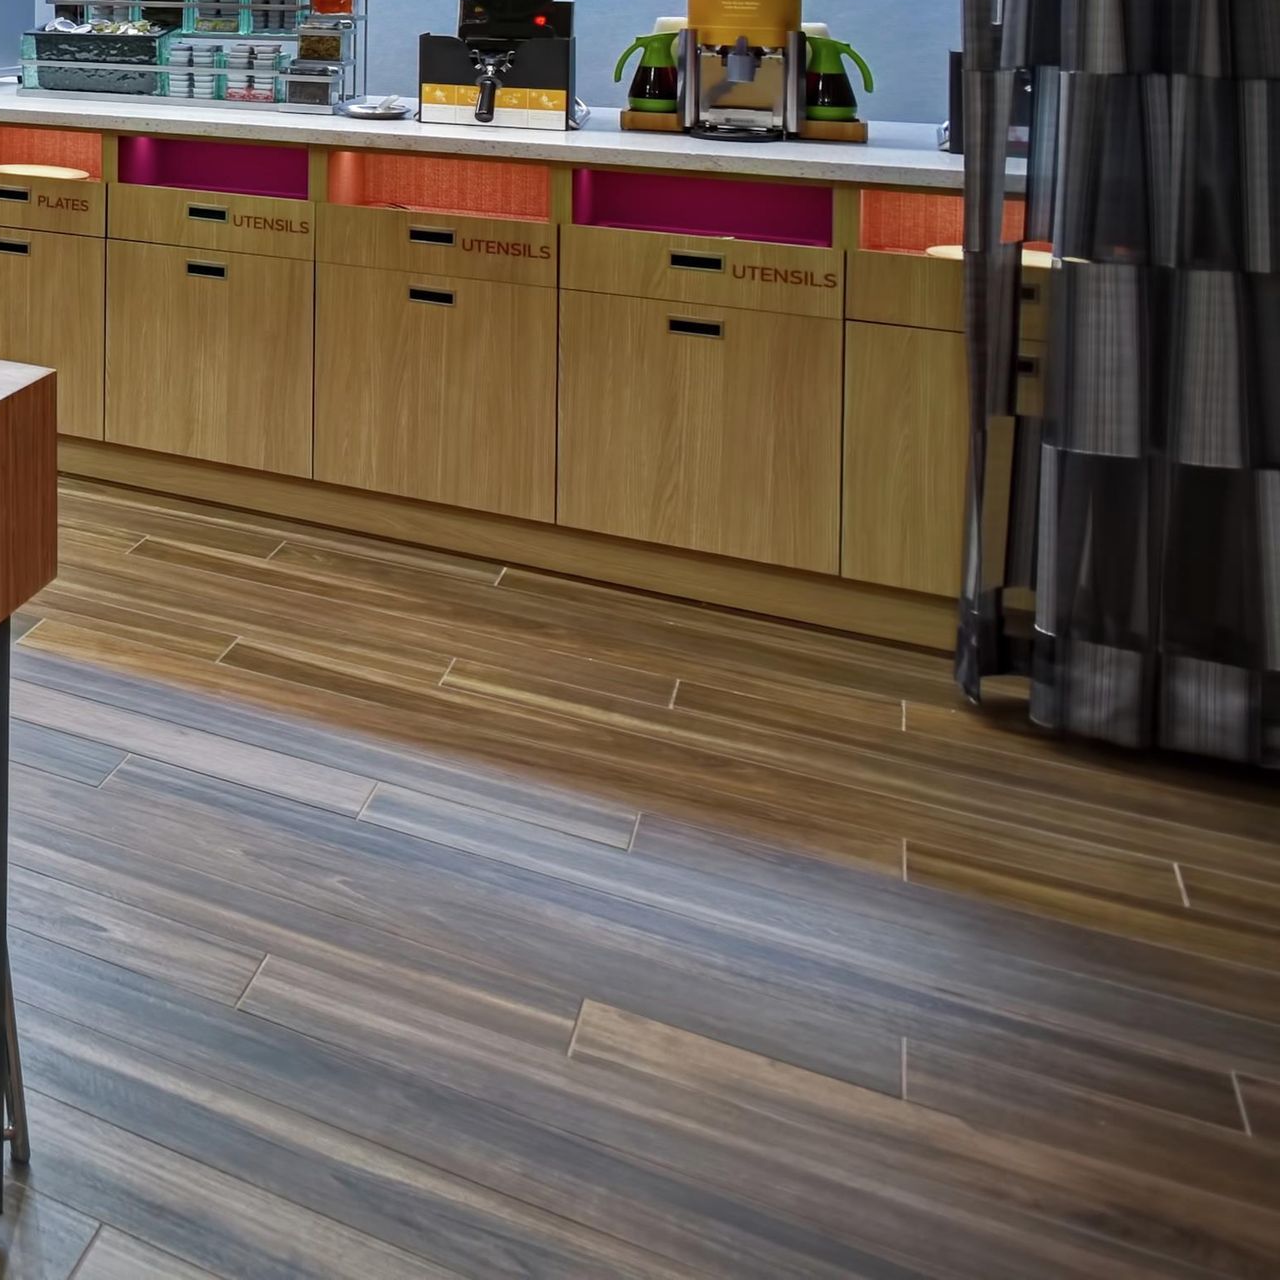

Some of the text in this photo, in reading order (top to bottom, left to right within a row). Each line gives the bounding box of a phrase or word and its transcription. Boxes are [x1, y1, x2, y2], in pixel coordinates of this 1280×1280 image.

[37, 194, 89, 212] PLATES
[232, 214, 310, 234] UTENSILS
[461, 237, 551, 260] UTENSILS
[732, 263, 838, 289] UTENSILS
